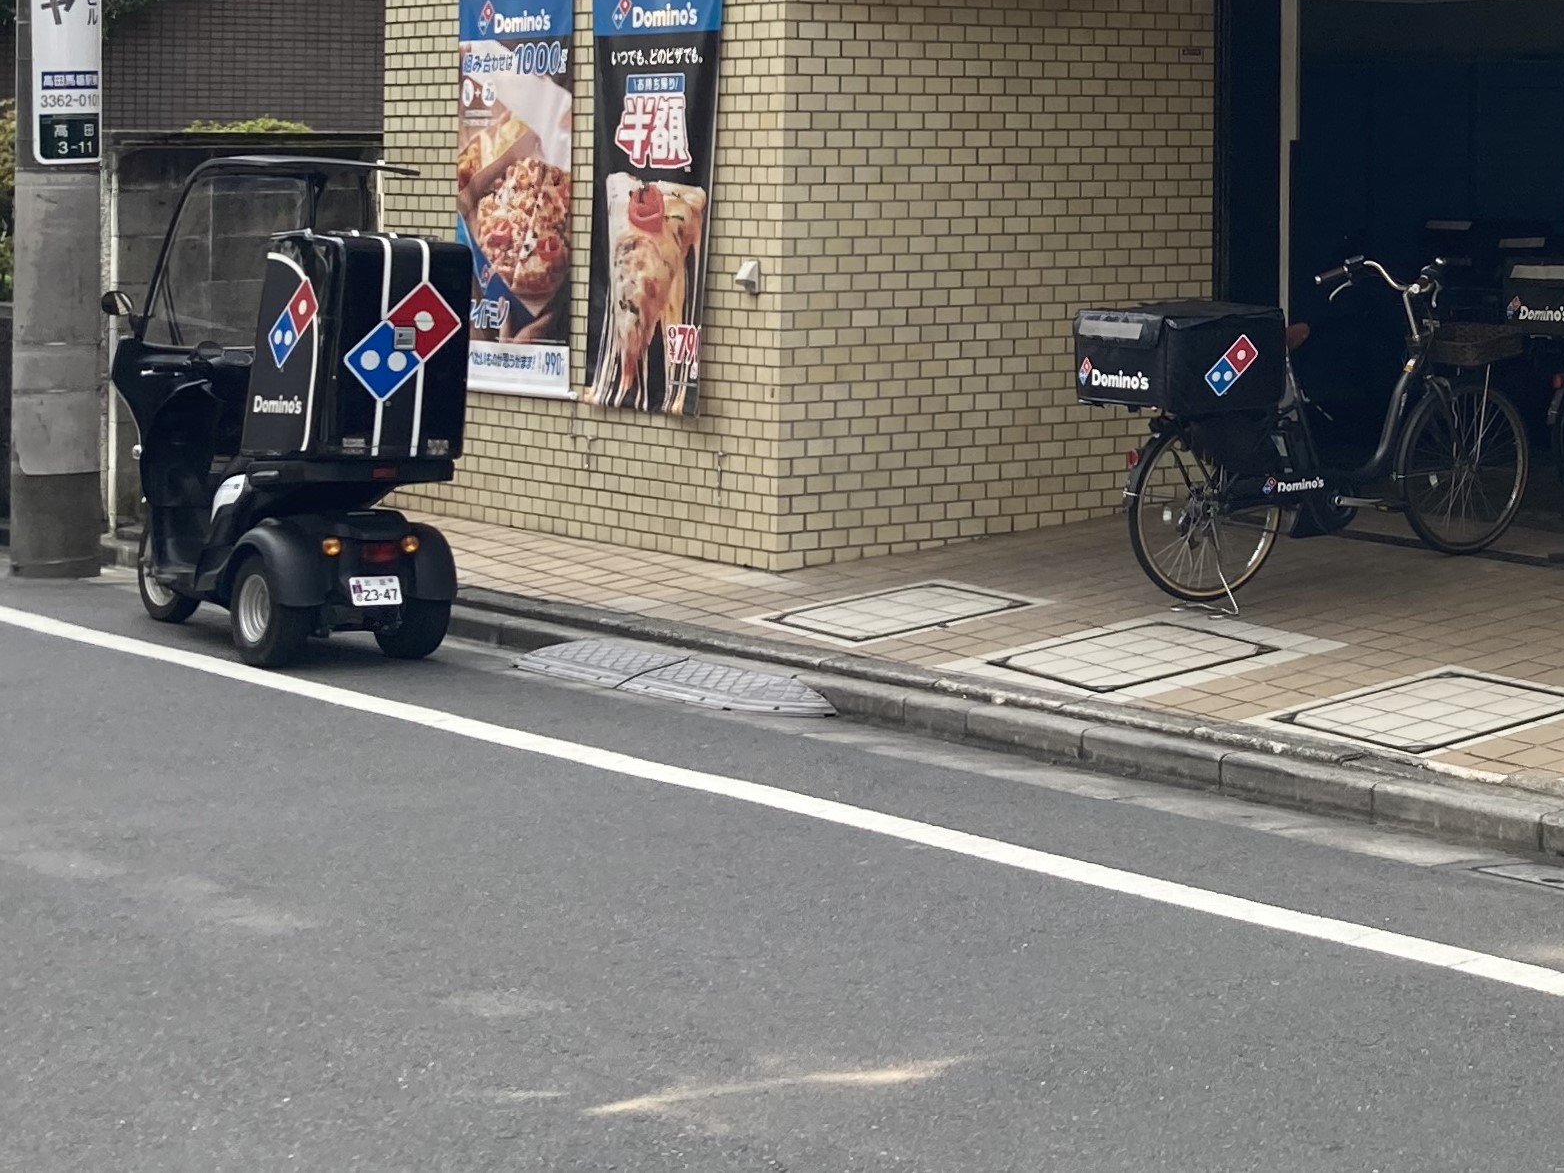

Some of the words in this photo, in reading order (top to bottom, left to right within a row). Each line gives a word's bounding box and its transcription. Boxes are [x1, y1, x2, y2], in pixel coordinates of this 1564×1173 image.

[494, 9, 550, 34] Domino's
[632, 1, 698, 29] Domino's
[617, 95, 690, 165] 半額
[58, 141, 93, 155] 3-11
[1091, 368, 1149, 391] Domino's
[253, 395, 302, 414] Domino's
[1277, 475, 1325, 493] Domino's
[363, 588, 398, 602] 23-47
